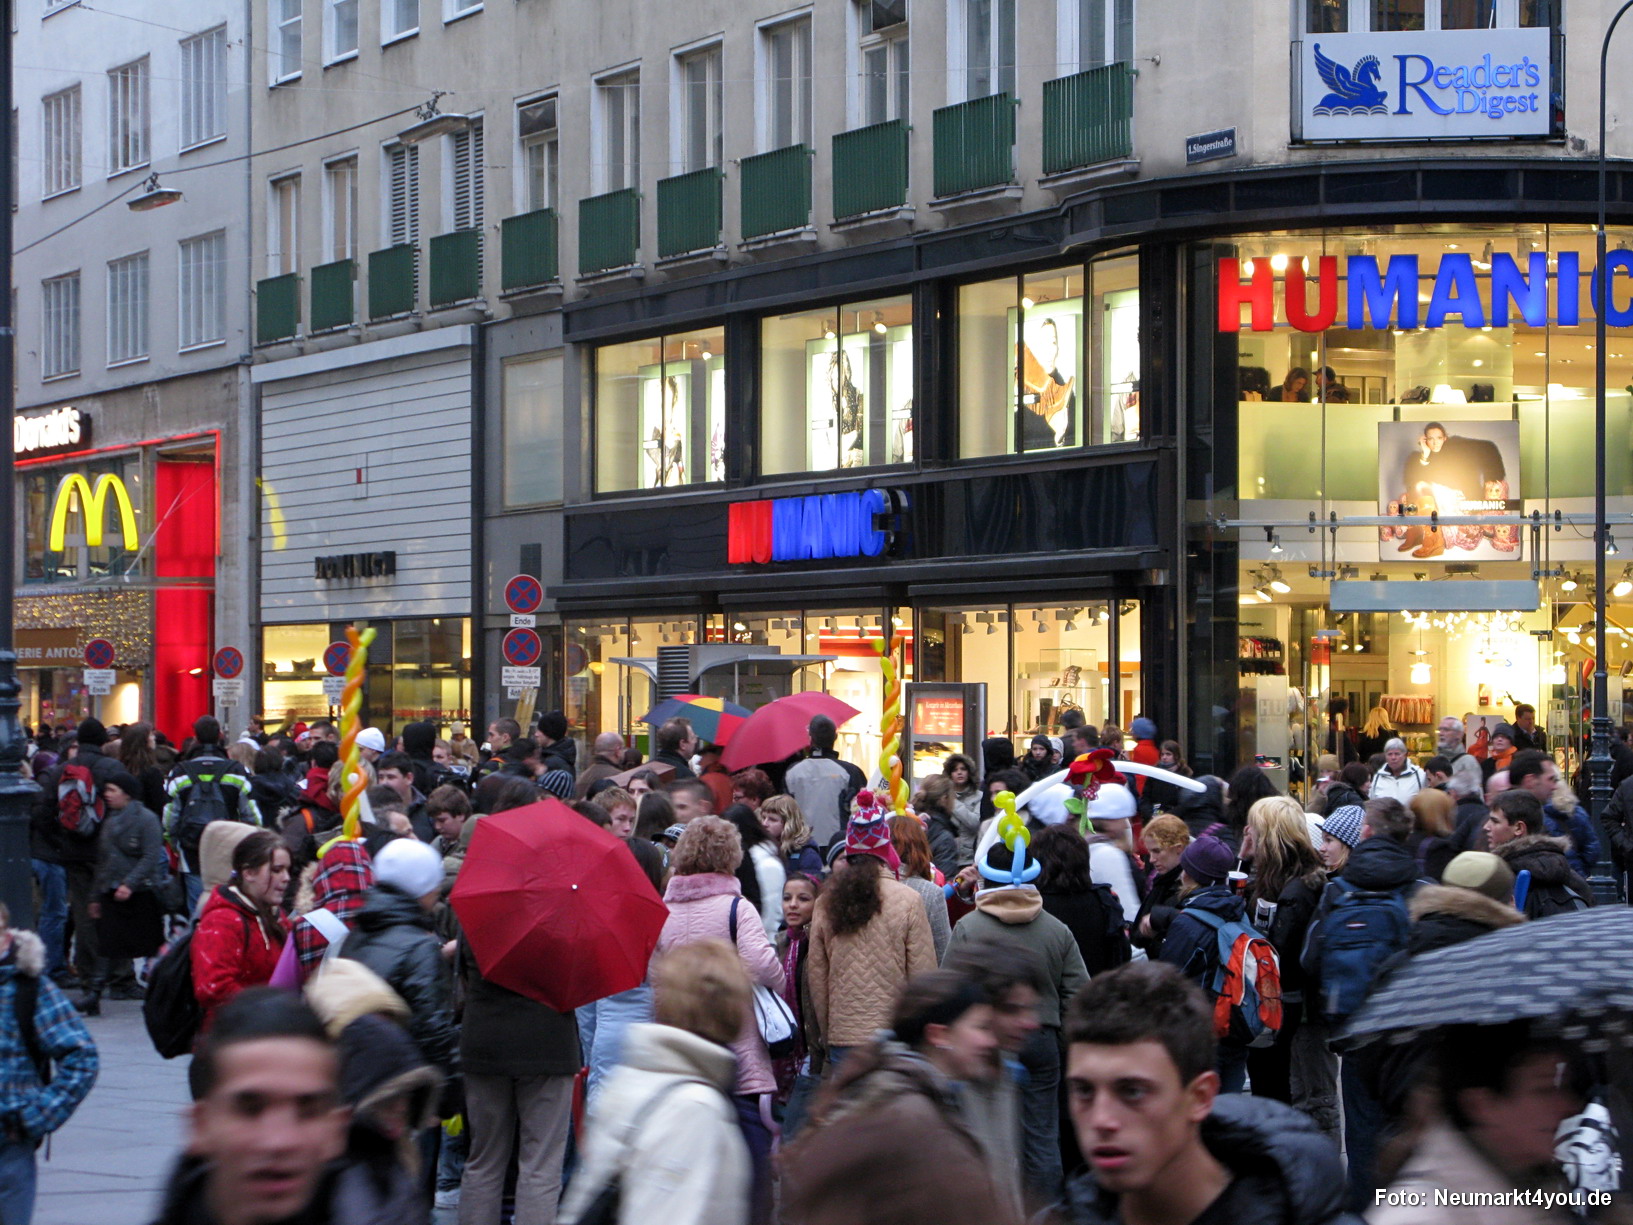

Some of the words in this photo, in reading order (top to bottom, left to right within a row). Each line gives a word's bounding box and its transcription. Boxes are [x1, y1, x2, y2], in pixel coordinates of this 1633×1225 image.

[1392, 53, 1540, 116] Reader's
[1455, 88, 1539, 119] Digest
[1218, 249, 1633, 332] HUMANIC
[728, 489, 885, 564] HUMANIC
[1460, 500, 1506, 511] MANIC
[514, 617, 532, 625] Ende
